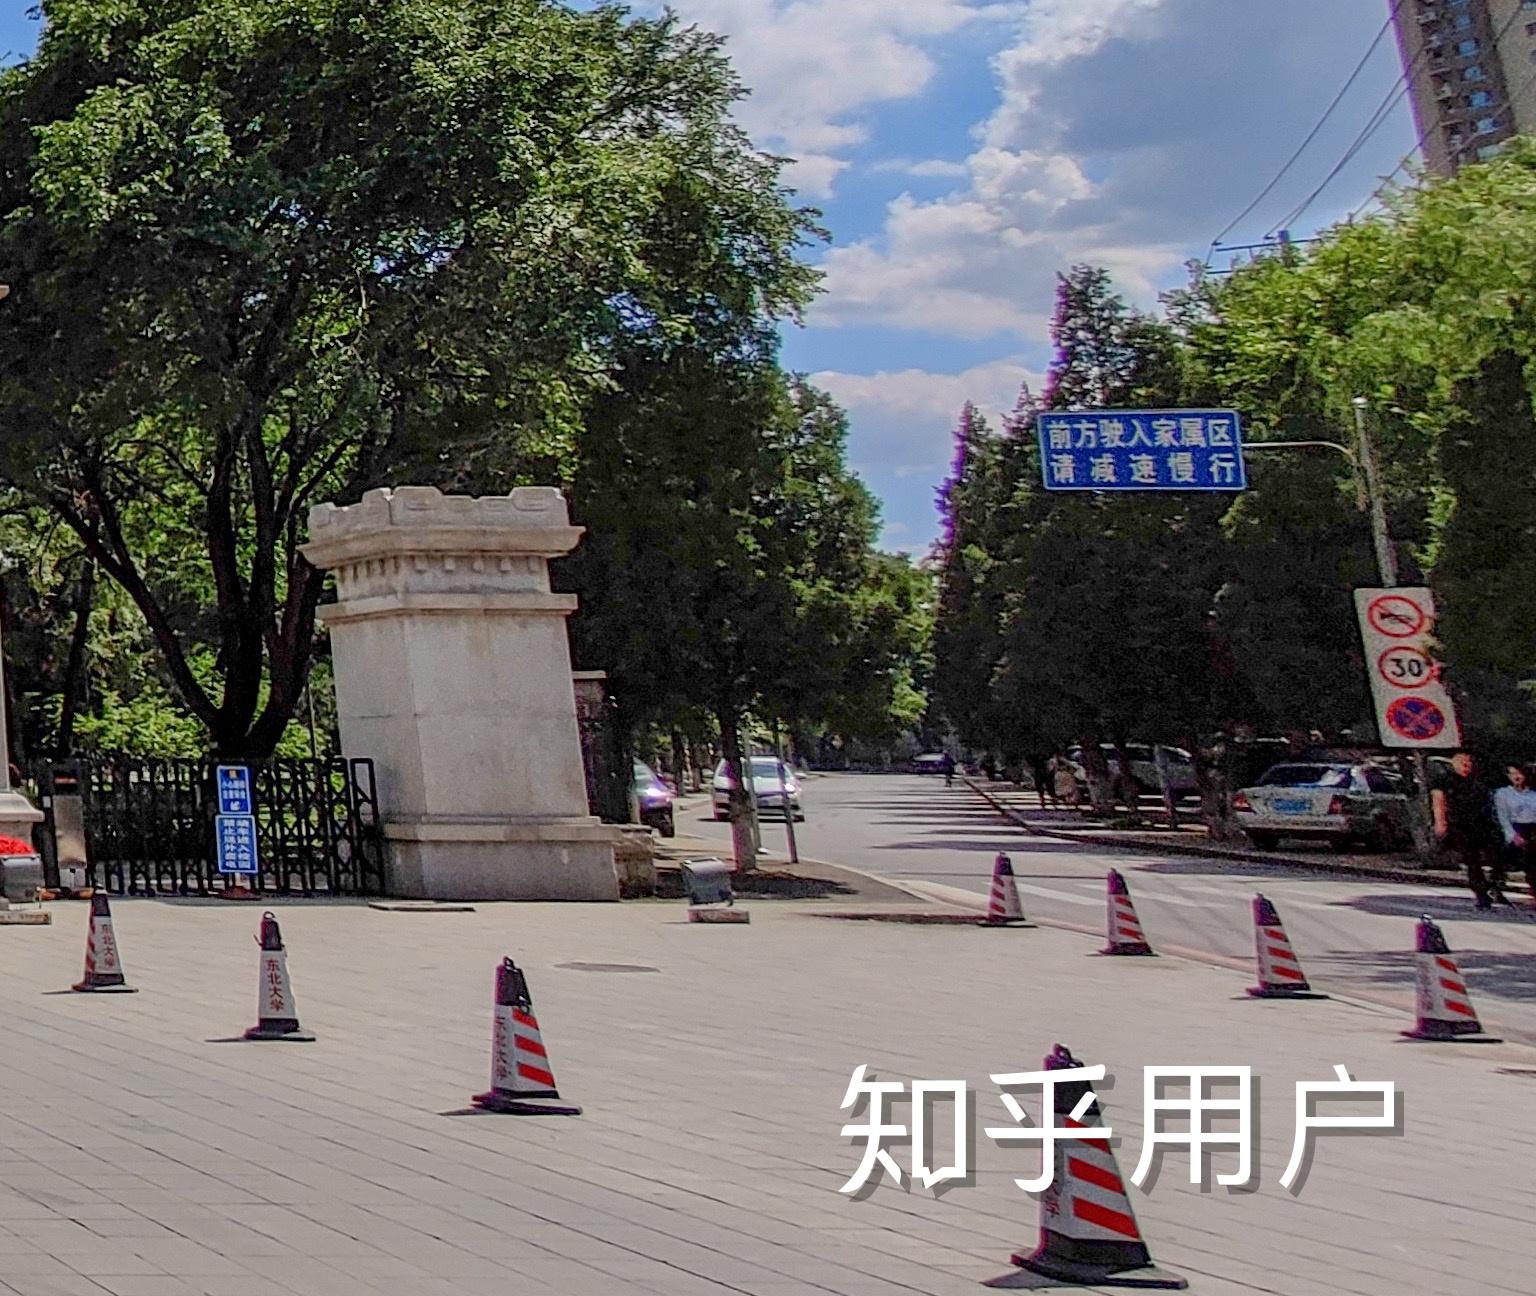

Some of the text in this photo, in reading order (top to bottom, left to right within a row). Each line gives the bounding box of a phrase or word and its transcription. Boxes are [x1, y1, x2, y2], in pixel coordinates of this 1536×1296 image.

[1047, 417, 1234, 449] 前方驶入家属区
[1050, 452, 1236, 484] 请减速慢行
[1390, 658, 1423, 678] 30
[265, 958, 284, 1013] 东北大学
